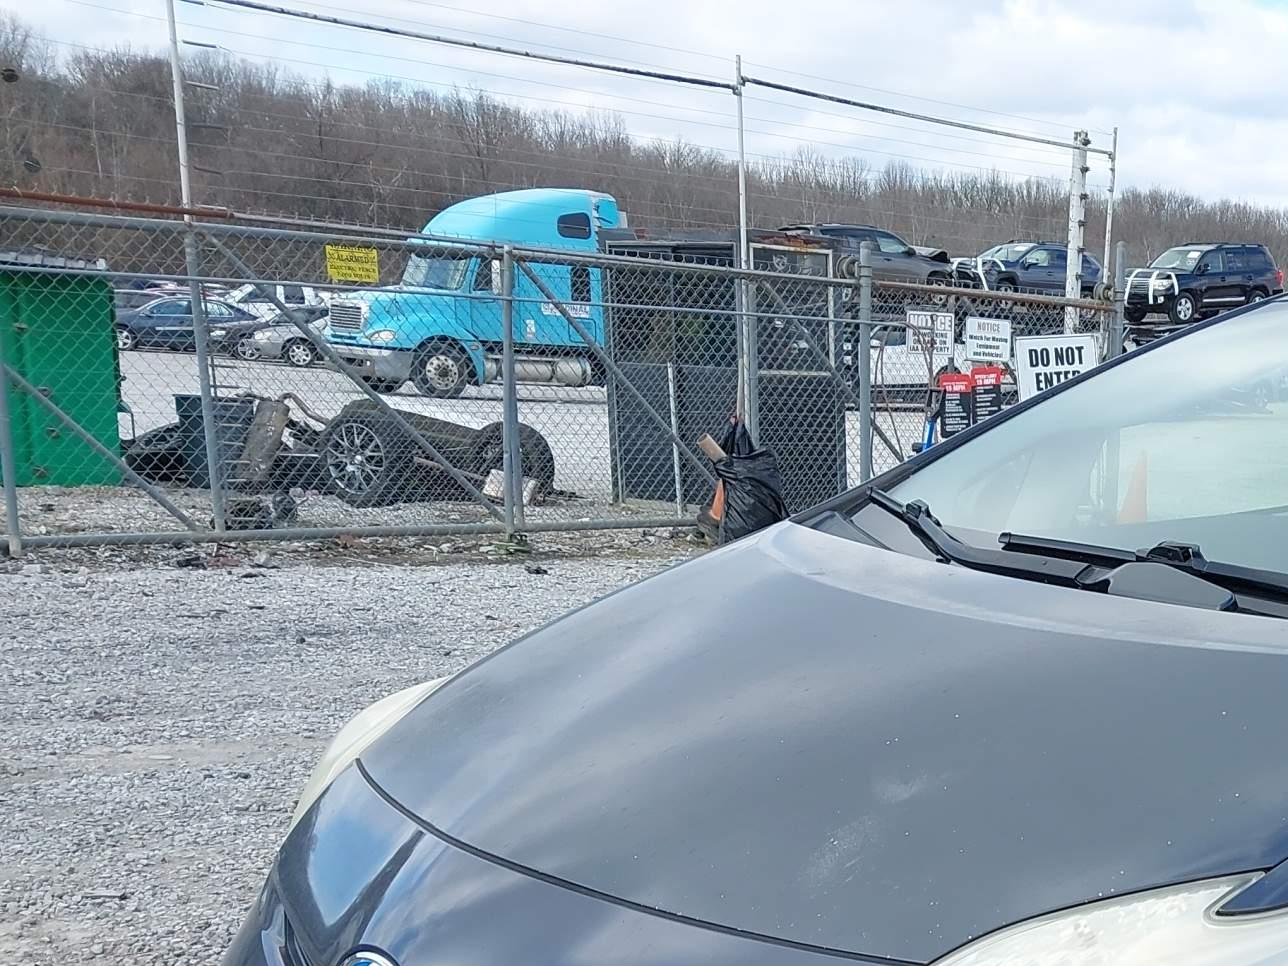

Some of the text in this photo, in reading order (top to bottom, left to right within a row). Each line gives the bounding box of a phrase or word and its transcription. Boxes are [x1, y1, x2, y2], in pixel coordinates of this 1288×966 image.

[977, 321, 1000, 332] NOTICE
[1028, 346, 1084, 368] DO NOT
